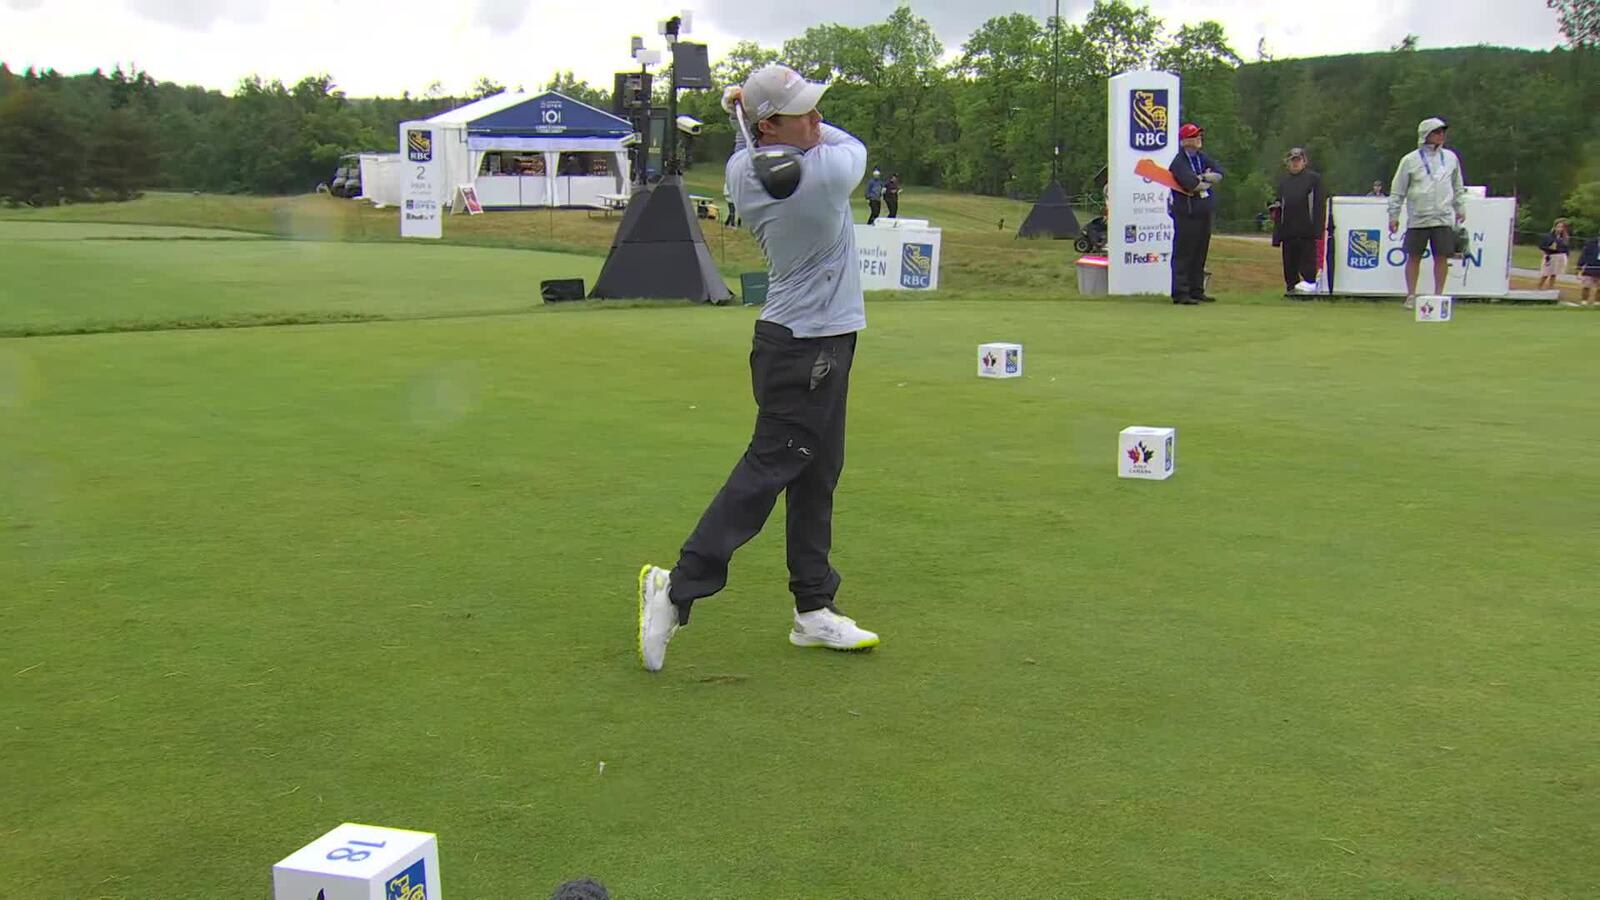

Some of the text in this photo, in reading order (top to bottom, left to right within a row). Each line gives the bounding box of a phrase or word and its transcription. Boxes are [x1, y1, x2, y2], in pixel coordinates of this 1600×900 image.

[1135, 132, 1166, 146] RBC
[410, 152, 431, 161] RBC
[416, 166, 425, 180] 2
[1133, 192, 1164, 203] PAR 4
[1138, 231, 1171, 242] OPEN
[1132, 252, 1159, 264] FedEx
[1350, 257, 1377, 267] RBC
[1386, 246, 1482, 268] OPN
[860, 259, 887, 276] PEN
[903, 274, 929, 287] RBC
[325, 840, 387, 862] 18
